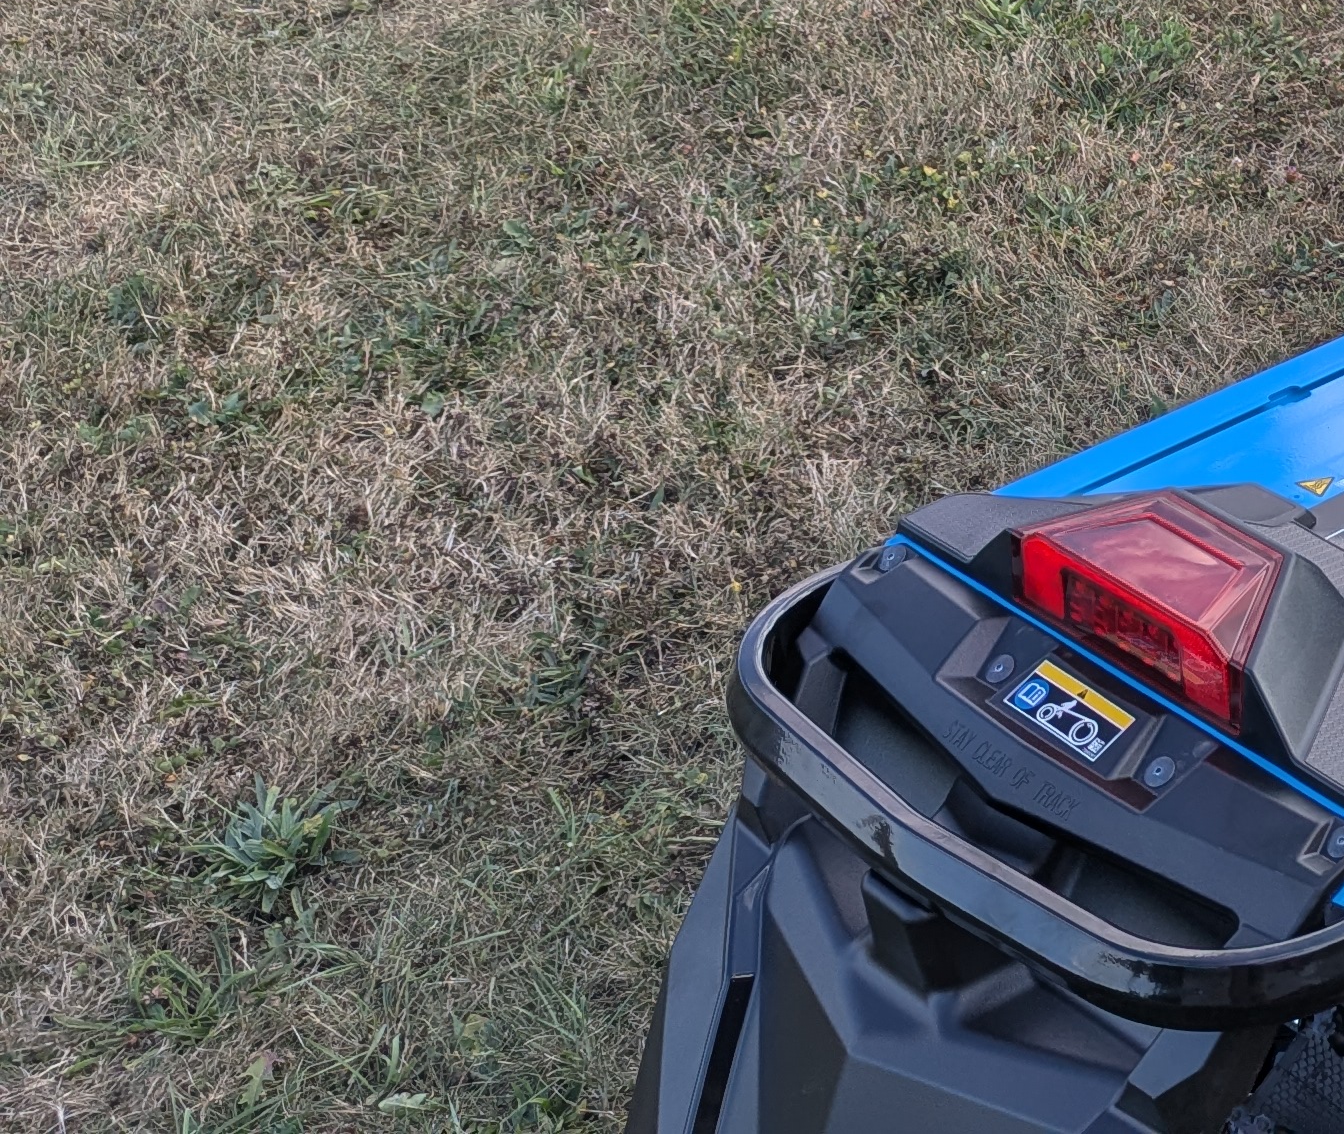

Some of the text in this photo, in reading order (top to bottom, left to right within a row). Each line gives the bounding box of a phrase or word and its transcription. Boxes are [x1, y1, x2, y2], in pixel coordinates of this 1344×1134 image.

[942, 719, 1081, 822] STAY CLEAR OF TRACK
